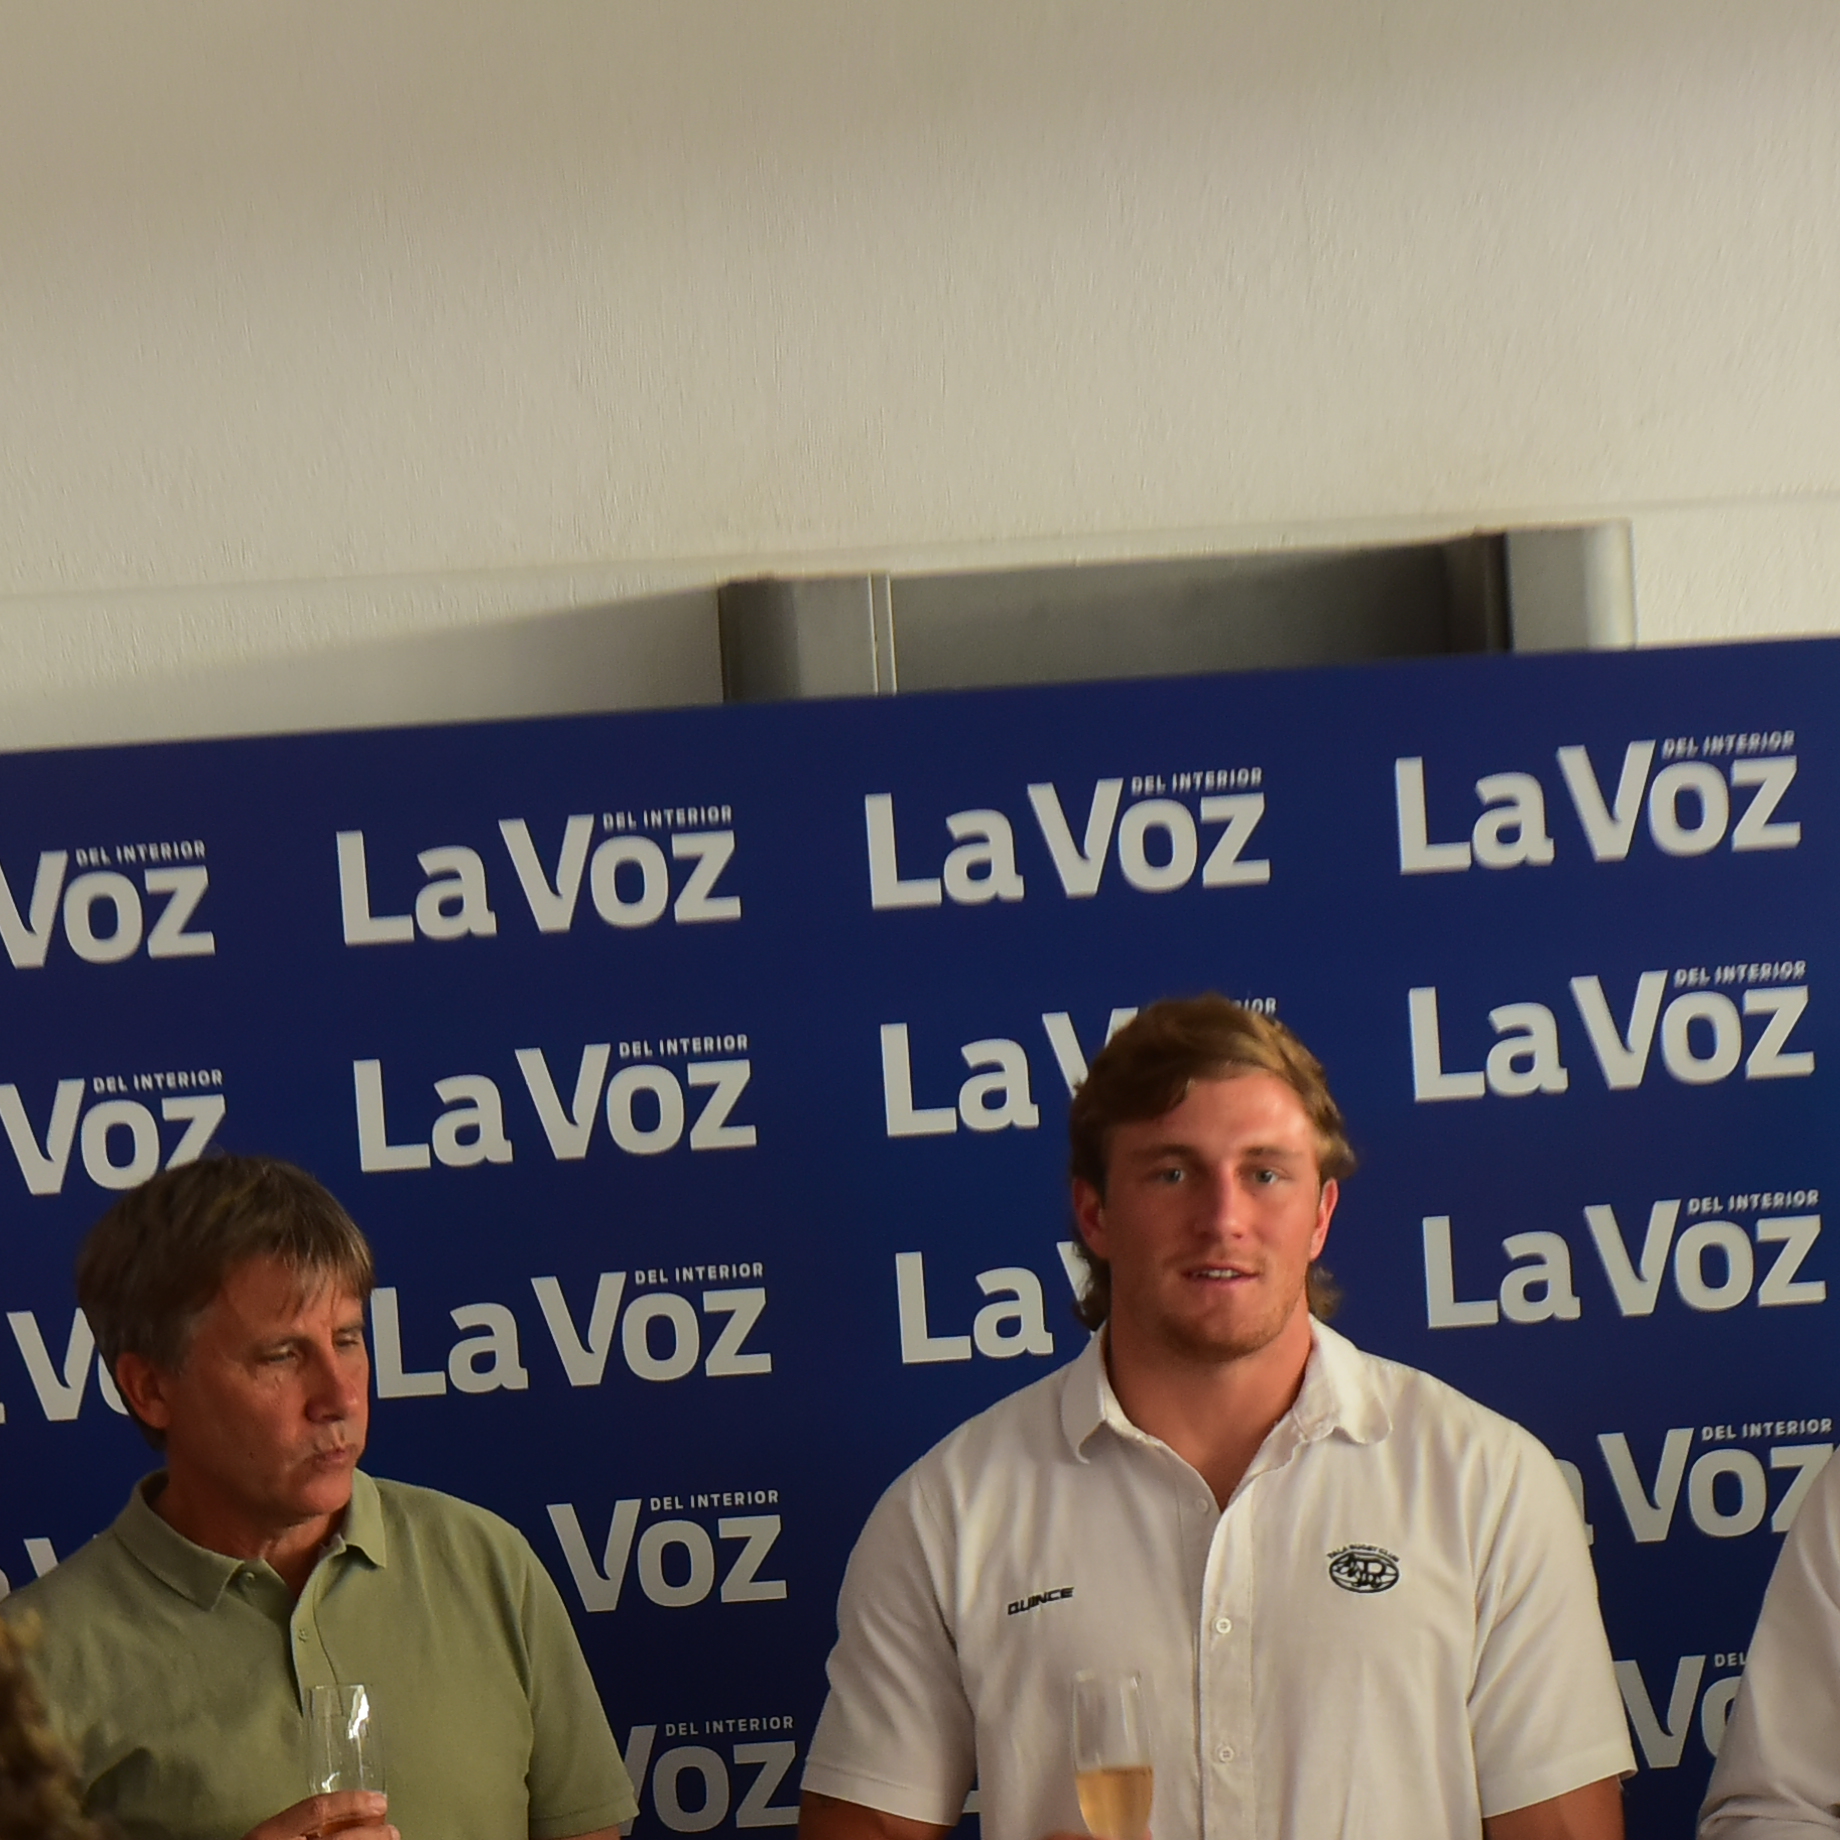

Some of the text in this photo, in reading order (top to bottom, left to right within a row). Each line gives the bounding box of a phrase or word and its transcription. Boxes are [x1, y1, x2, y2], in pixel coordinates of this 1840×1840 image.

[1660, 729, 1792, 756] DEL INTERIOR
[1130, 765, 1262, 793] DEL INTERIOR
[602, 803, 733, 830] DEL INTERIOR
[75, 838, 206, 865] DEL INTERIOR
[1674, 959, 1805, 986] DEL INTERIOR
[618, 1032, 748, 1058] DEL INTERIOR
[92, 1066, 222, 1093] DEL INTERIOR
[1687, 1187, 1819, 1214] DEL INTERIOR
[633, 1259, 764, 1286] DEL INTERIOR
[1701, 1415, 1832, 1442] DEL INTERIOR
[649, 1486, 779, 1513] DEL INTERIOR
[546, 1497, 788, 1613] Voz
[1007, 1586, 1075, 1616] QUINCE
[664, 1712, 795, 1739] DEL INTERIOR
